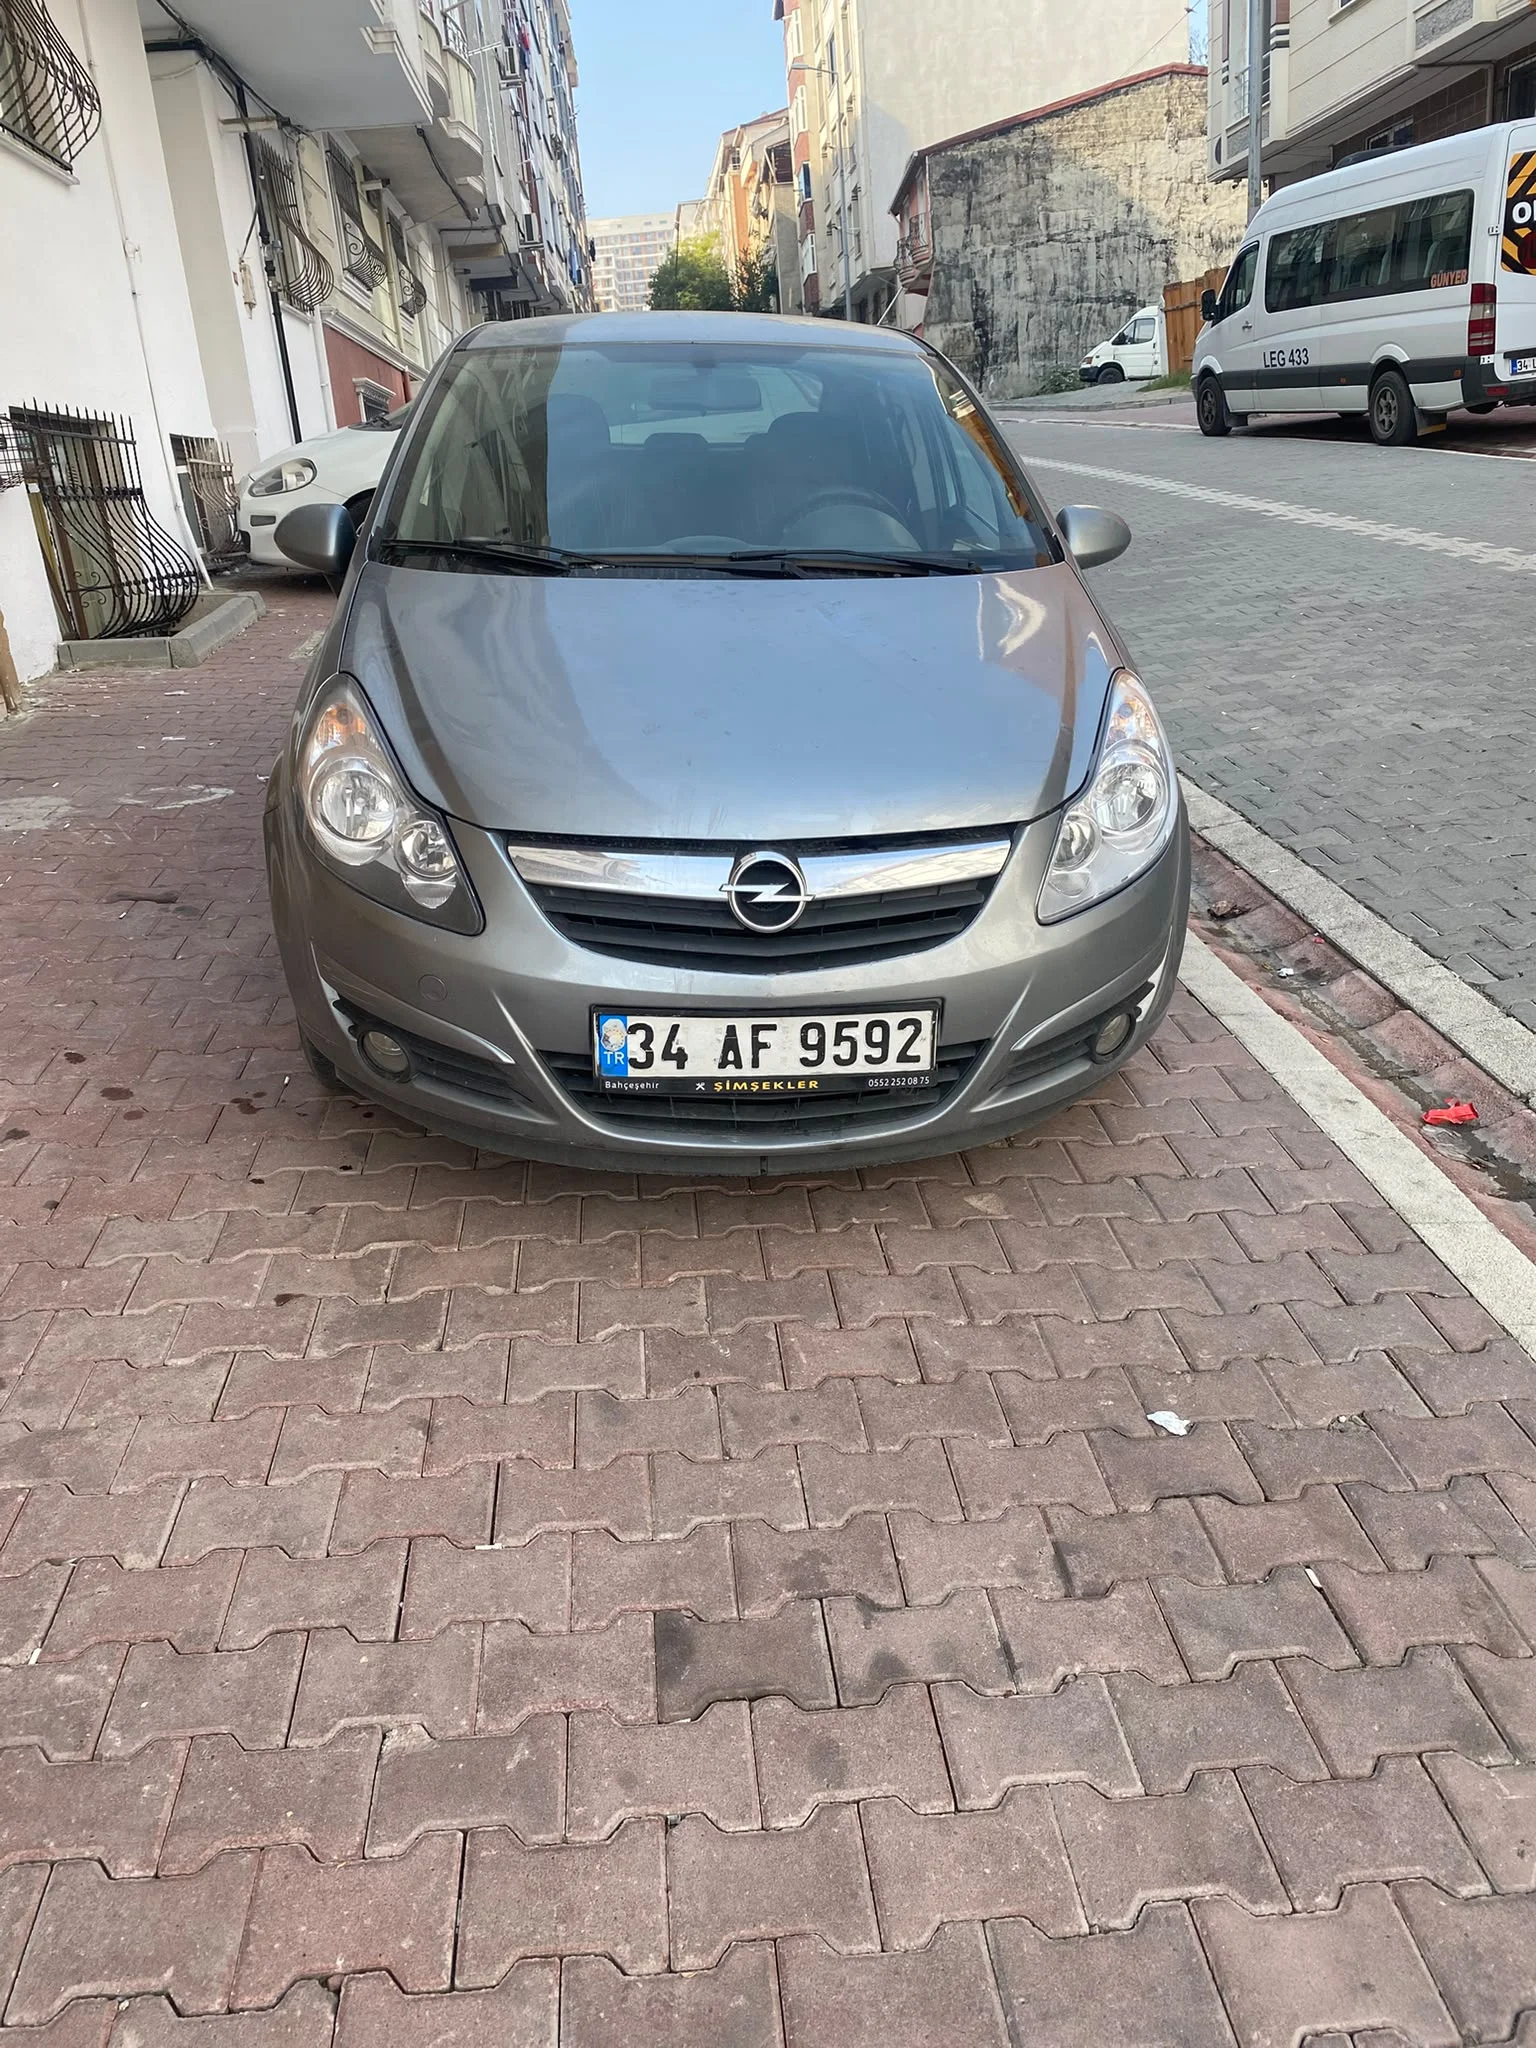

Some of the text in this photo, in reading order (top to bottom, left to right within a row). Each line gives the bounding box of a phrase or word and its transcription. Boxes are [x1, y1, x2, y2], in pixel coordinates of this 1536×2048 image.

[1430, 269, 1468, 288] GÜNYER
[1263, 348, 1309, 368] LEG 433
[1517, 360, 1528, 371] 34
[627, 1018, 922, 1070] 34 AF 9592
[603, 1051, 625, 1065] TR
[604, 1081, 660, 1090] Bahçeşehir
[713, 1079, 820, 1092] ŞİMŞEKLER
[868, 1078, 890, 1088] 0552
[890, 1077, 906, 1087] 252
